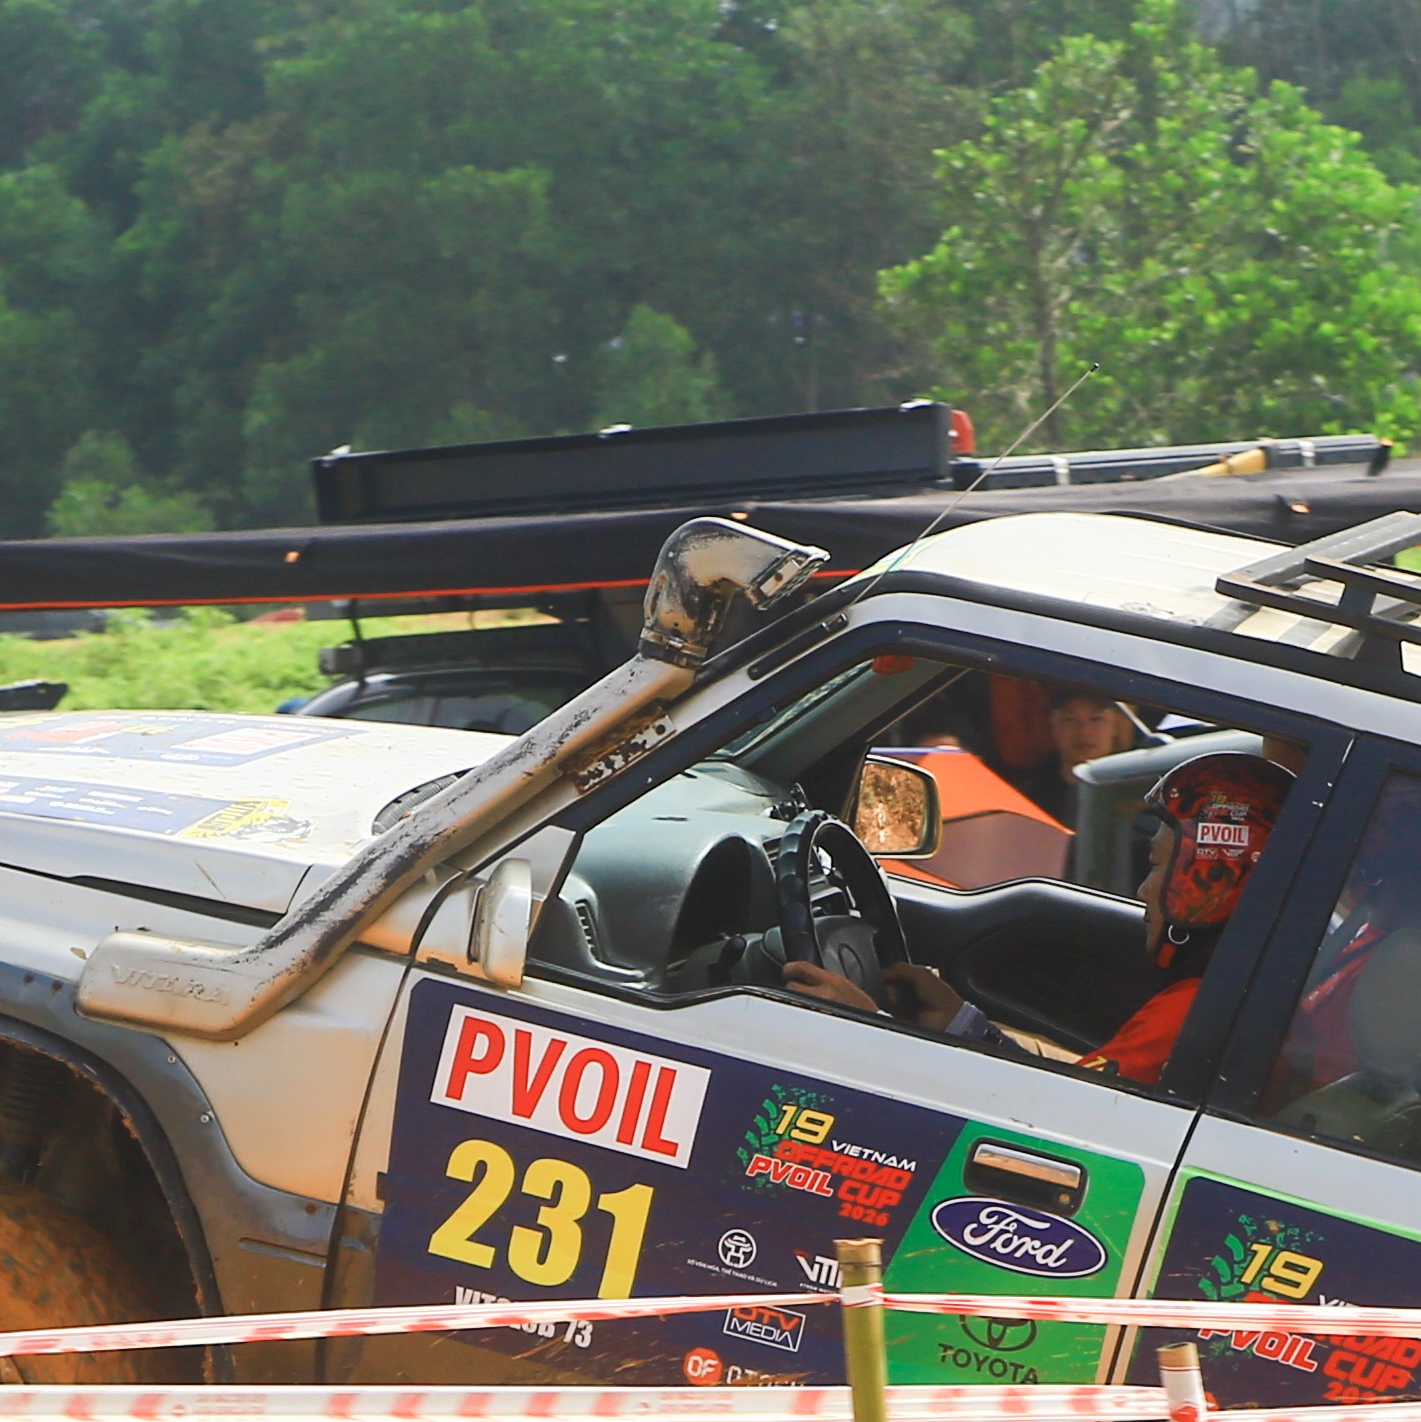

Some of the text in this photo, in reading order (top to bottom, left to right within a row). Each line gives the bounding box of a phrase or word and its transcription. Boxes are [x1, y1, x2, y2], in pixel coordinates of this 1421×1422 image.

[1200, 825, 1245, 843] PVOIL
[444, 1014, 680, 1158] PVOIL
[773, 1139, 914, 1191] OFFROAD
[775, 1104, 918, 1172] 19 VIETNAM
[745, 1153, 903, 1209] PVOIL CUP
[427, 1138, 655, 1299] 231
[963, 1206, 1075, 1268] Ford
[1239, 1242, 1324, 1300] 19
[730, 1317, 795, 1349] MEDIA
[938, 1342, 1039, 1385] TOYOTA
[1323, 1350, 1412, 1393] CUP
[1323, 1382, 1395, 1405] 20
